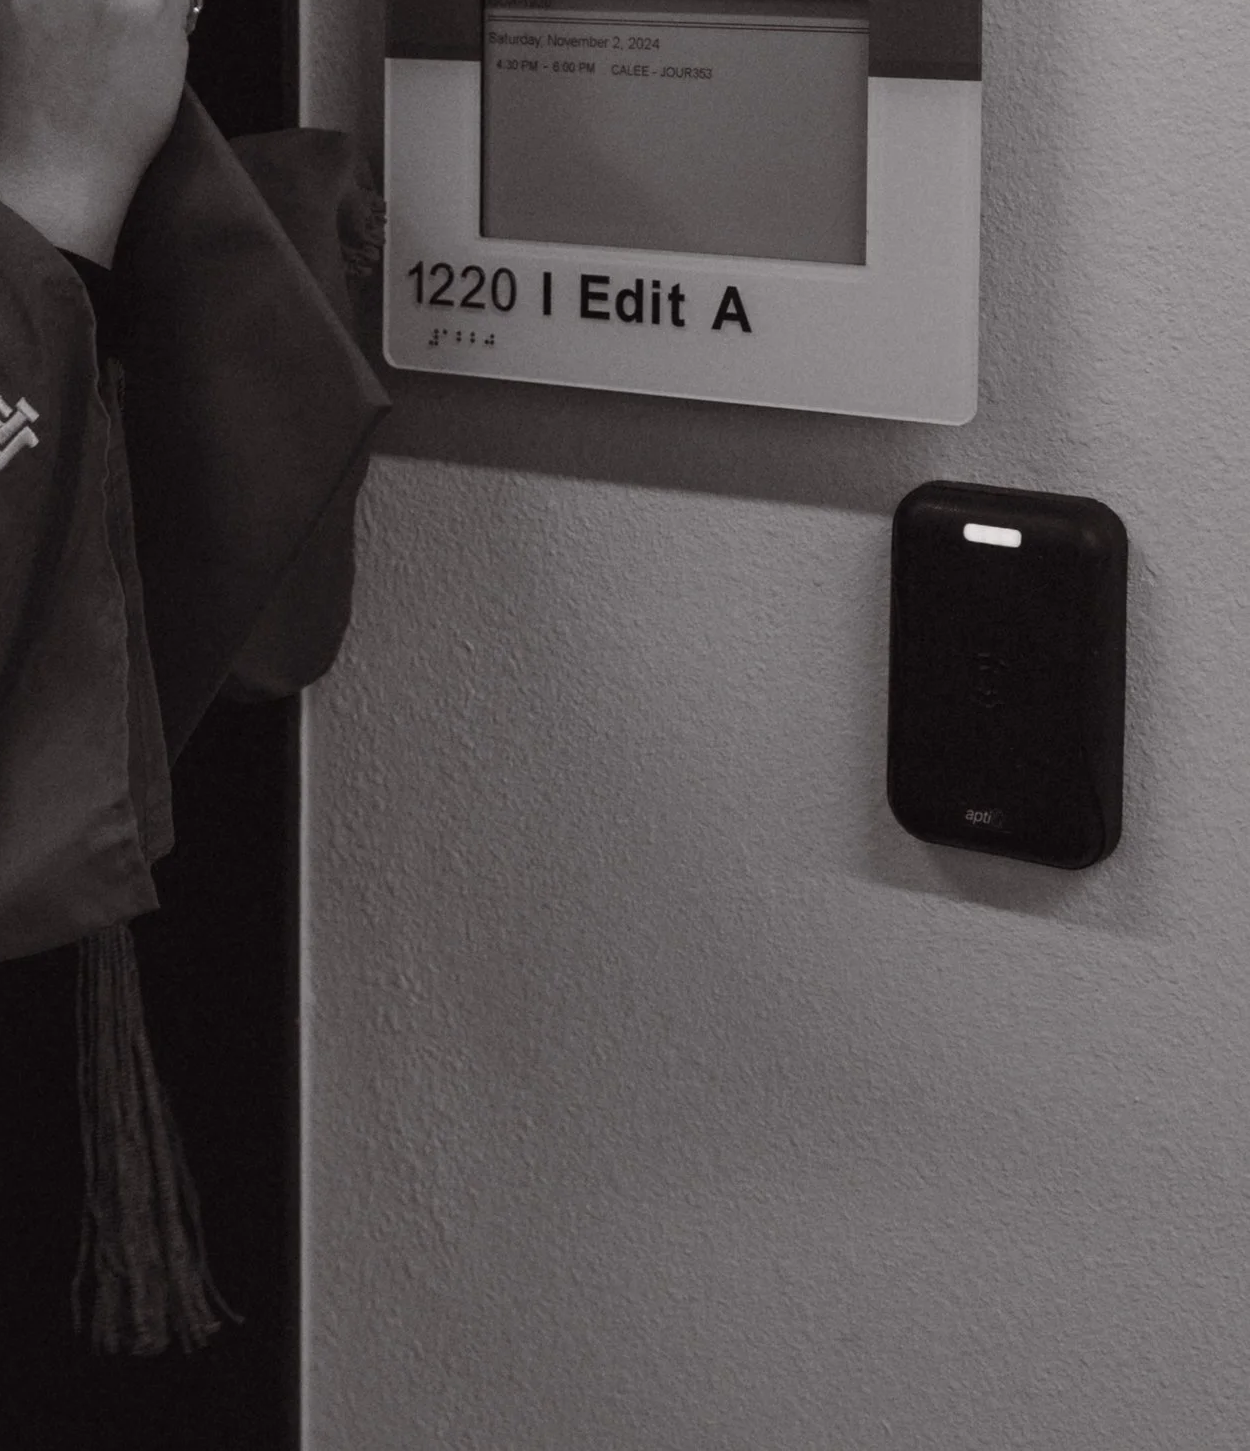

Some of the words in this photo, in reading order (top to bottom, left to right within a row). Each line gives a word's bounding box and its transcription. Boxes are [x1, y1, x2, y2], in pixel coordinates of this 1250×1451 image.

[489, 32, 543, 48] Saturday,
[547, 34, 609, 49] November
[629, 37, 660, 50] 2024
[520, 59, 539, 71] PM
[578, 61, 596, 73] PM
[611, 64, 650, 77] CALEE
[408, 261, 517, 312] 1220
[580, 274, 686, 327] Edit
[711, 285, 753, 333] A
